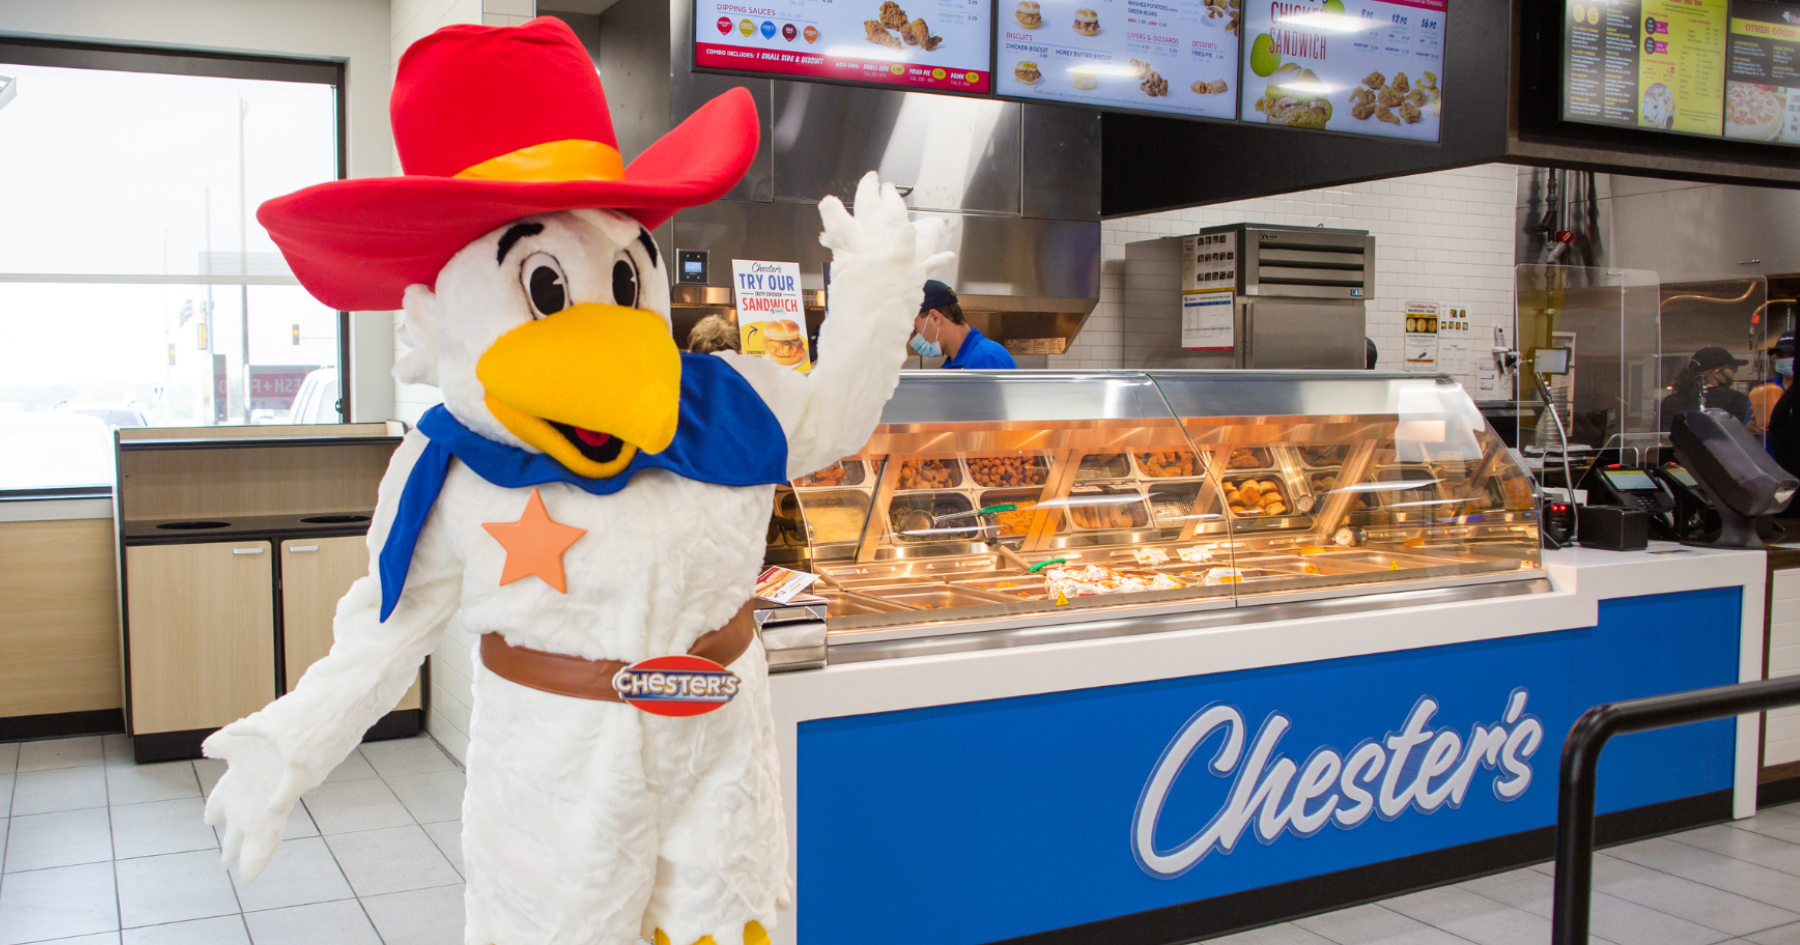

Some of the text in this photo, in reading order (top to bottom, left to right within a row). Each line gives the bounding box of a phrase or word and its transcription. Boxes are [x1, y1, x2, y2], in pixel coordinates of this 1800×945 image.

[717, 3, 747, 13] DIPPING
[748, 7, 776, 16] SAUCES
[1127, 8, 1158, 17] GREEN BEANS
[1147, 2, 1169, 11] POTATOES
[1271, 1, 1329, 31] CHICK
[1391, 13, 1408, 25] 12 PC
[1421, 18, 1437, 29] 16 PC
[1006, 31, 1033, 41] BISCUITS
[1745, 23, 1796, 38] OTHER GOODS
[1127, 32, 1146, 40] LIVERS
[1152, 35, 1180, 45] GIZZARDS
[1269, 27, 1327, 60] SANDWICH
[1005, 42, 1028, 51] CHICKEN
[1029, 45, 1049, 53] BISCUIT
[1191, 40, 1218, 50] DESSERTS
[706, 48, 726, 56] COMBO
[727, 50, 755, 59] INCLUDES:
[761, 52, 780, 61] SMALL
[781, 54, 794, 62] SIDE
[801, 56, 824, 65] BISCUIT
[1055, 49, 1073, 57] HONEY
[1073, 50, 1093, 59] BUTTER
[1093, 53, 1112, 61] BISCUIT
[1191, 49, 1205, 58] FRIED
[950, 72, 965, 80] DRINK
[751, 262, 782, 273] Chester's
[739, 273, 795, 291] TRY OUR
[742, 297, 798, 312] SANDWICH
[616, 672, 740, 696] CHESTER'S
[1137, 690, 1543, 874] Chester's
